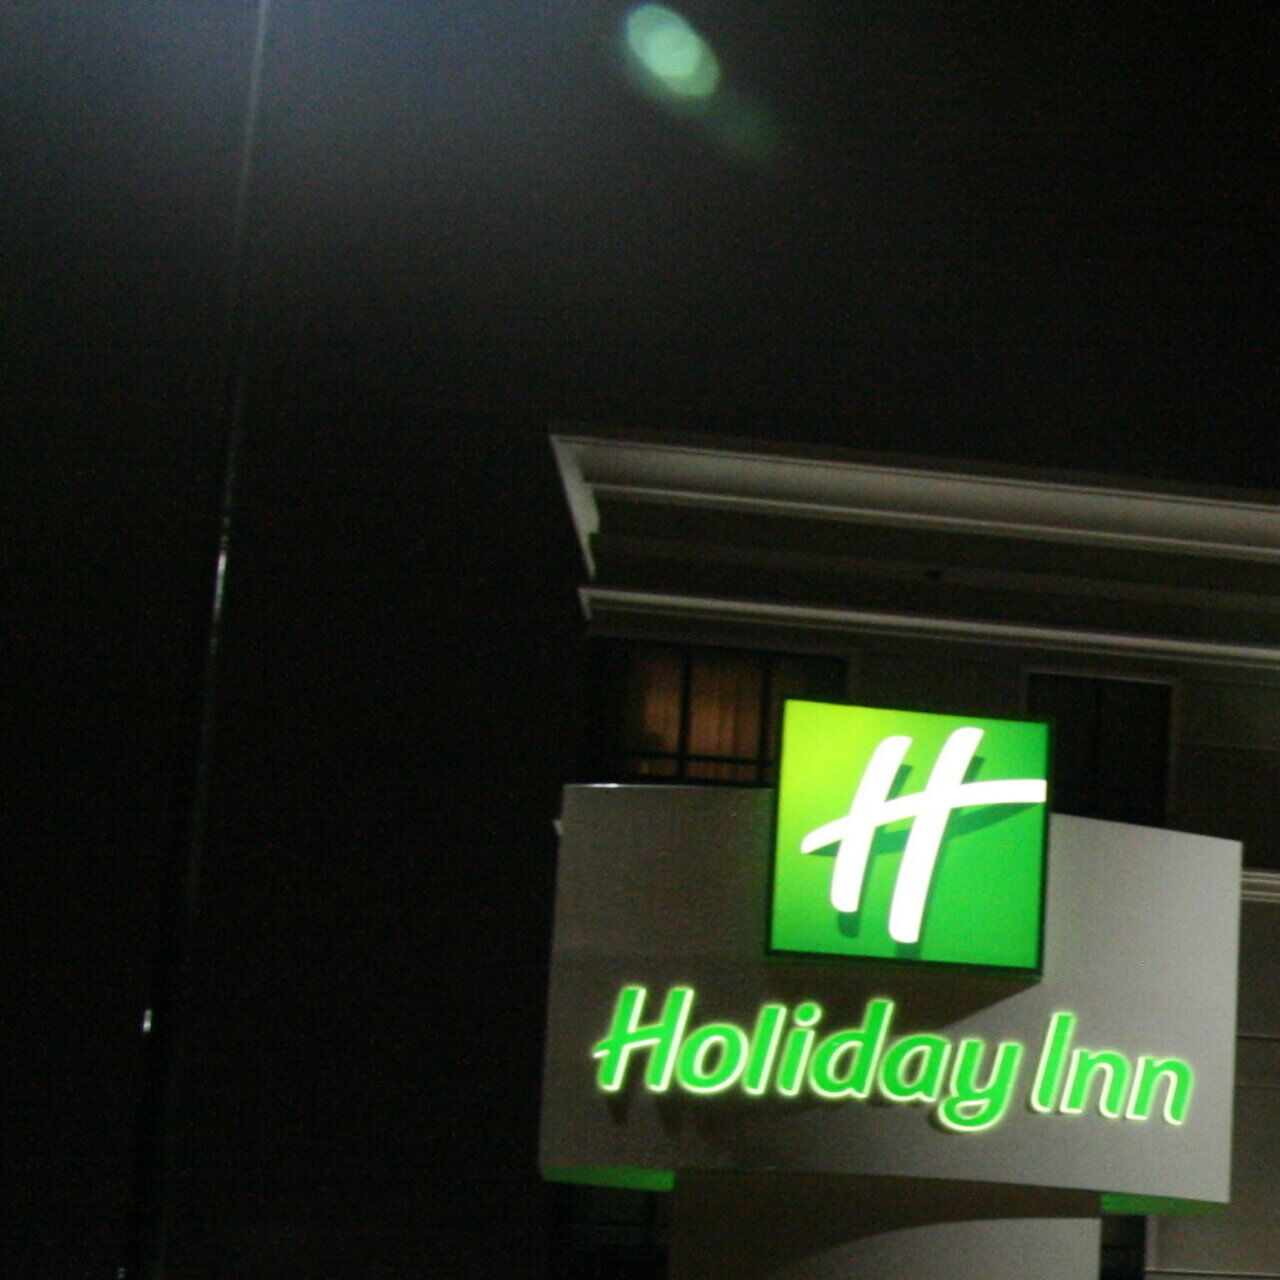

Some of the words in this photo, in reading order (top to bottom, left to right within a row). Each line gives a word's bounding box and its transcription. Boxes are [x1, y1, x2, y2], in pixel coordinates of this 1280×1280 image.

[800, 727, 1047, 944] H
[592, 984, 1022, 1132] Holiday
[1029, 1010, 1195, 1127] Inn
